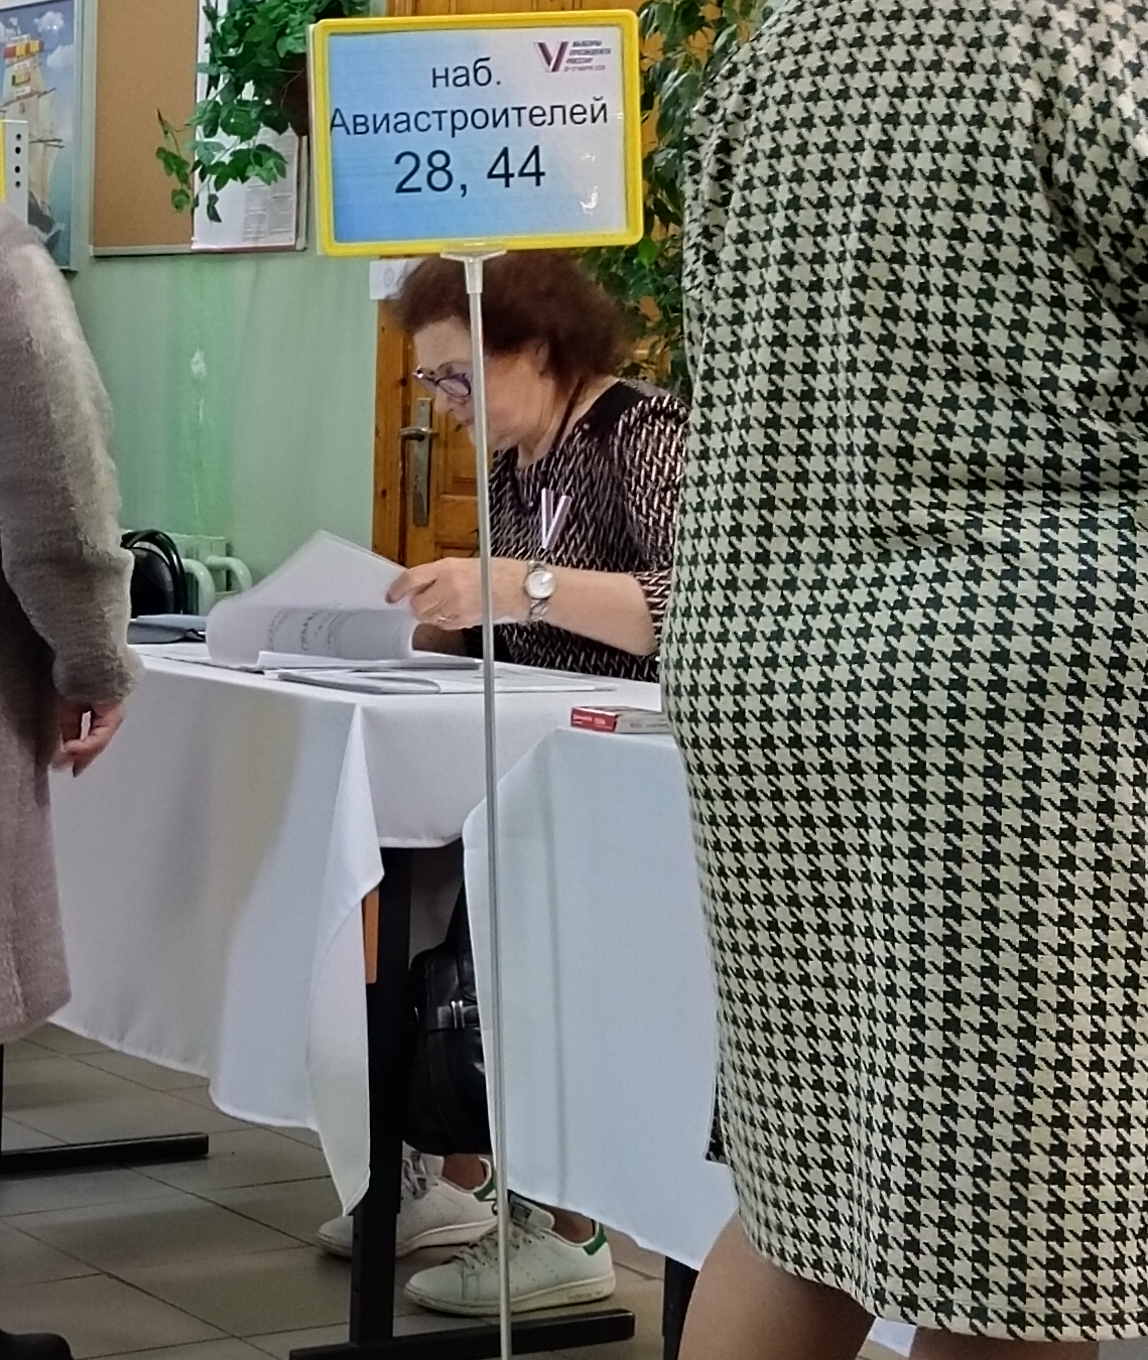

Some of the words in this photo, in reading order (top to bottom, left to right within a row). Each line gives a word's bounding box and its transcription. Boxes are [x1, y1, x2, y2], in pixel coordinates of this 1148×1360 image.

[431, 56, 502, 88] наб.
[330, 95, 609, 138] Авиастроителей
[393, 149, 468, 198] 28,
[486, 144, 546, 189] 44
